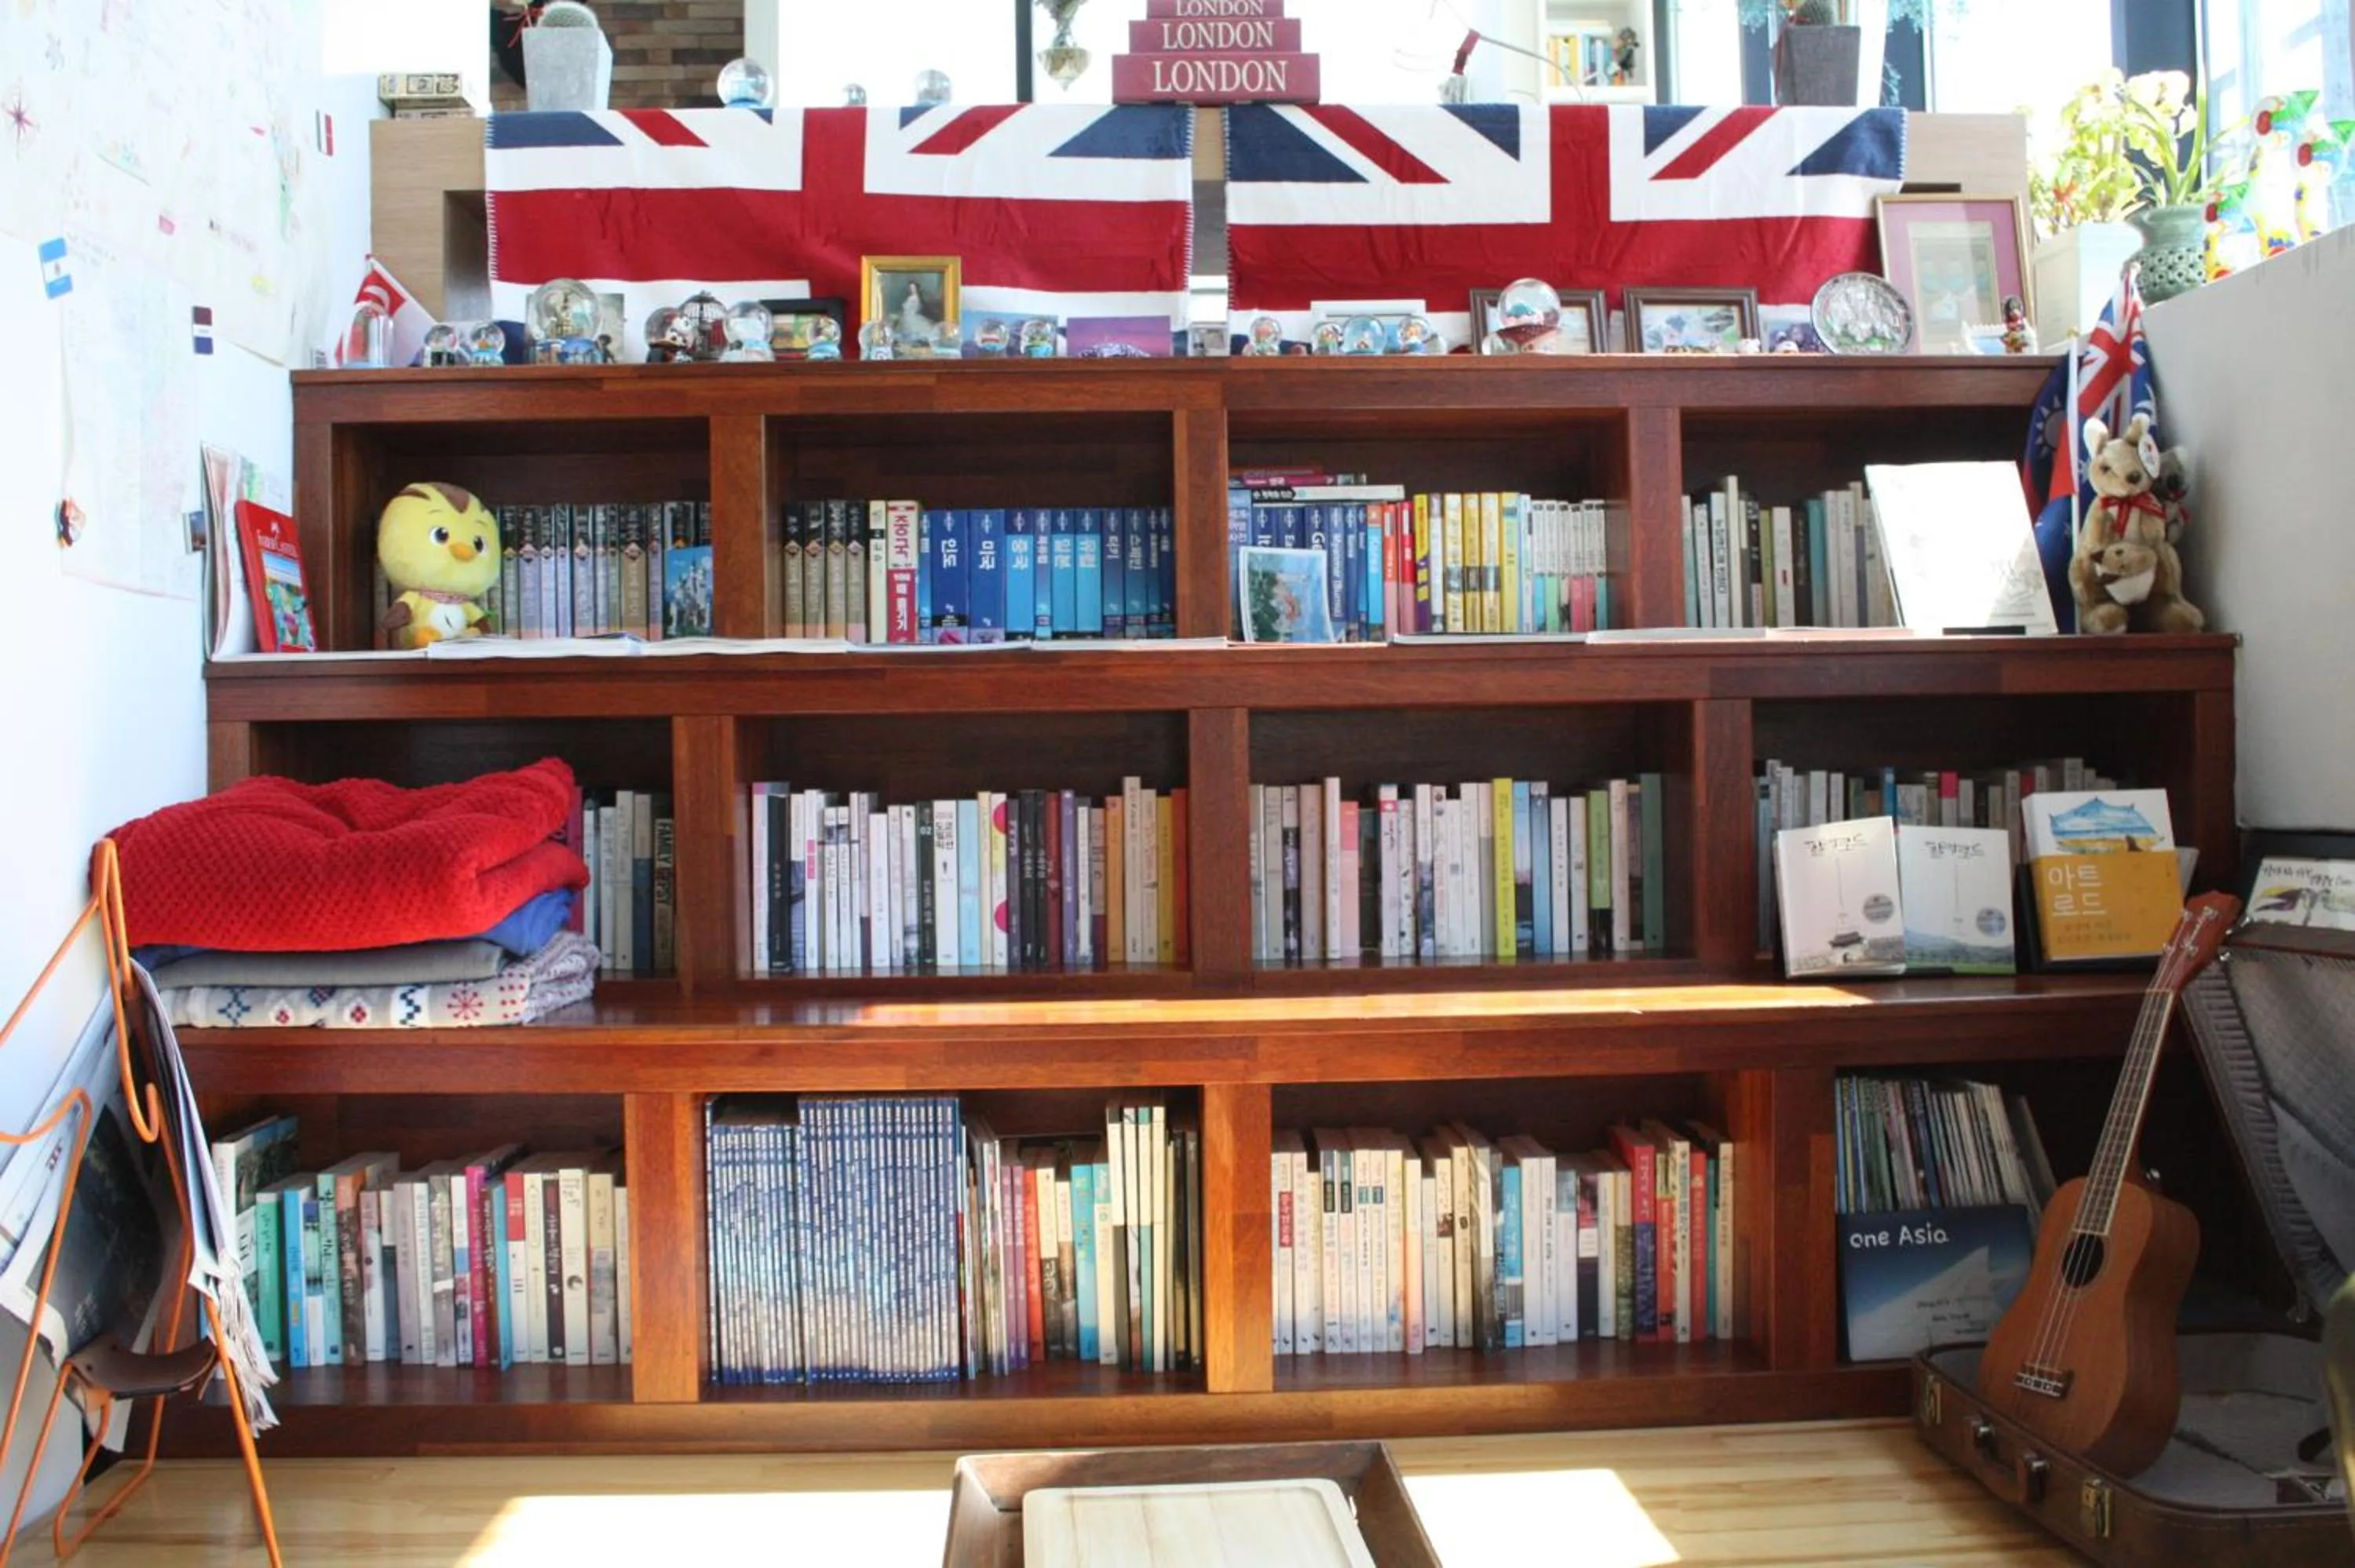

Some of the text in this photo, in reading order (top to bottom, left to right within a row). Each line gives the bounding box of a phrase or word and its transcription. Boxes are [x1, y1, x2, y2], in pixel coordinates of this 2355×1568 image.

[1176, 0, 1264, 16] LONDON
[1162, 21, 1274, 49] LONDON
[1152, 60, 1288, 93] LONDON
[894, 515, 910, 559] 중국
[1128, 534, 1144, 571] 스페인
[941, 538, 958, 569] 인도
[979, 540, 996, 571] 미국
[1012, 539, 1028, 570] 중국
[2048, 863, 2103, 890] 아트
[2051, 892, 2107, 917] 로드
[1849, 1222, 1950, 1248] one Asia
